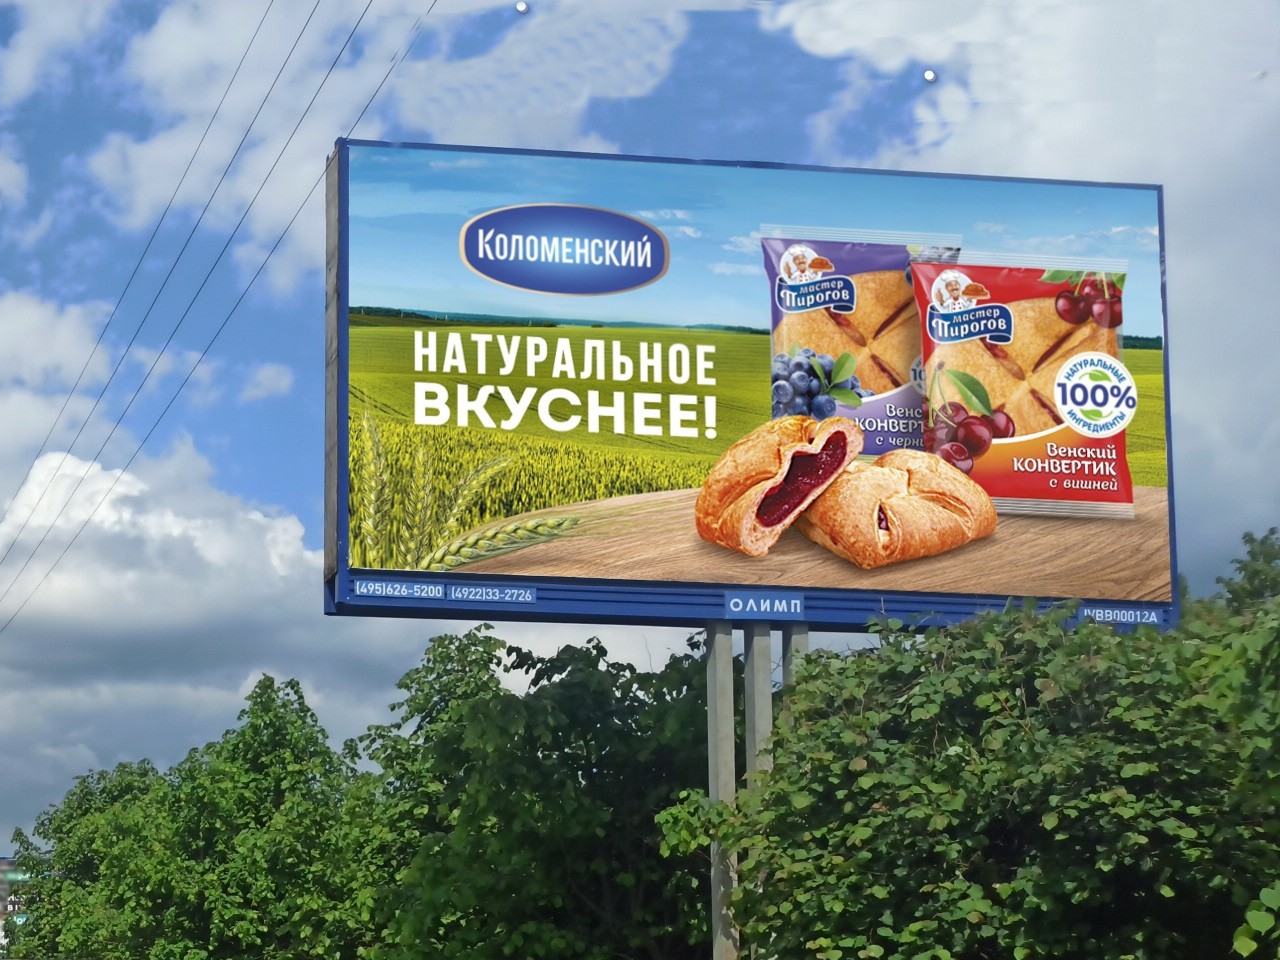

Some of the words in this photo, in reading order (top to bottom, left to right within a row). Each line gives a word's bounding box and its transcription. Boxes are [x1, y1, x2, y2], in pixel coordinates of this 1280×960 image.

[800, 280, 844, 294] мастер
[780, 290, 850, 307] Пирогов
[953, 308, 1000, 323] мастер
[931, 318, 1007, 338] Пирогов
[414, 330, 717, 387] НАТУРАЛЬНОЕ
[1064, 358, 1127, 383] НАТУРАЛЬНЫЕ
[1057, 382, 1137, 409] 100%
[414, 381, 718, 440] ВКУСНЕЕ!
[886, 404, 923, 418] Венс
[855, 417, 924, 433] КОНВЕРТ
[1067, 409, 1127, 434] ИНГРЕДИЕНТЫ
[1046, 442, 1117, 459] Венский
[1013, 457, 1117, 475] КОНВЕРТИК
[1049, 478, 1058, 488] с
[1063, 478, 1118, 490] вишней
[356, 581, 443, 597] (495)626-5200
[451, 586, 532, 602] (4922)33-2726
[729, 598, 801, 613] ОЛИМП
